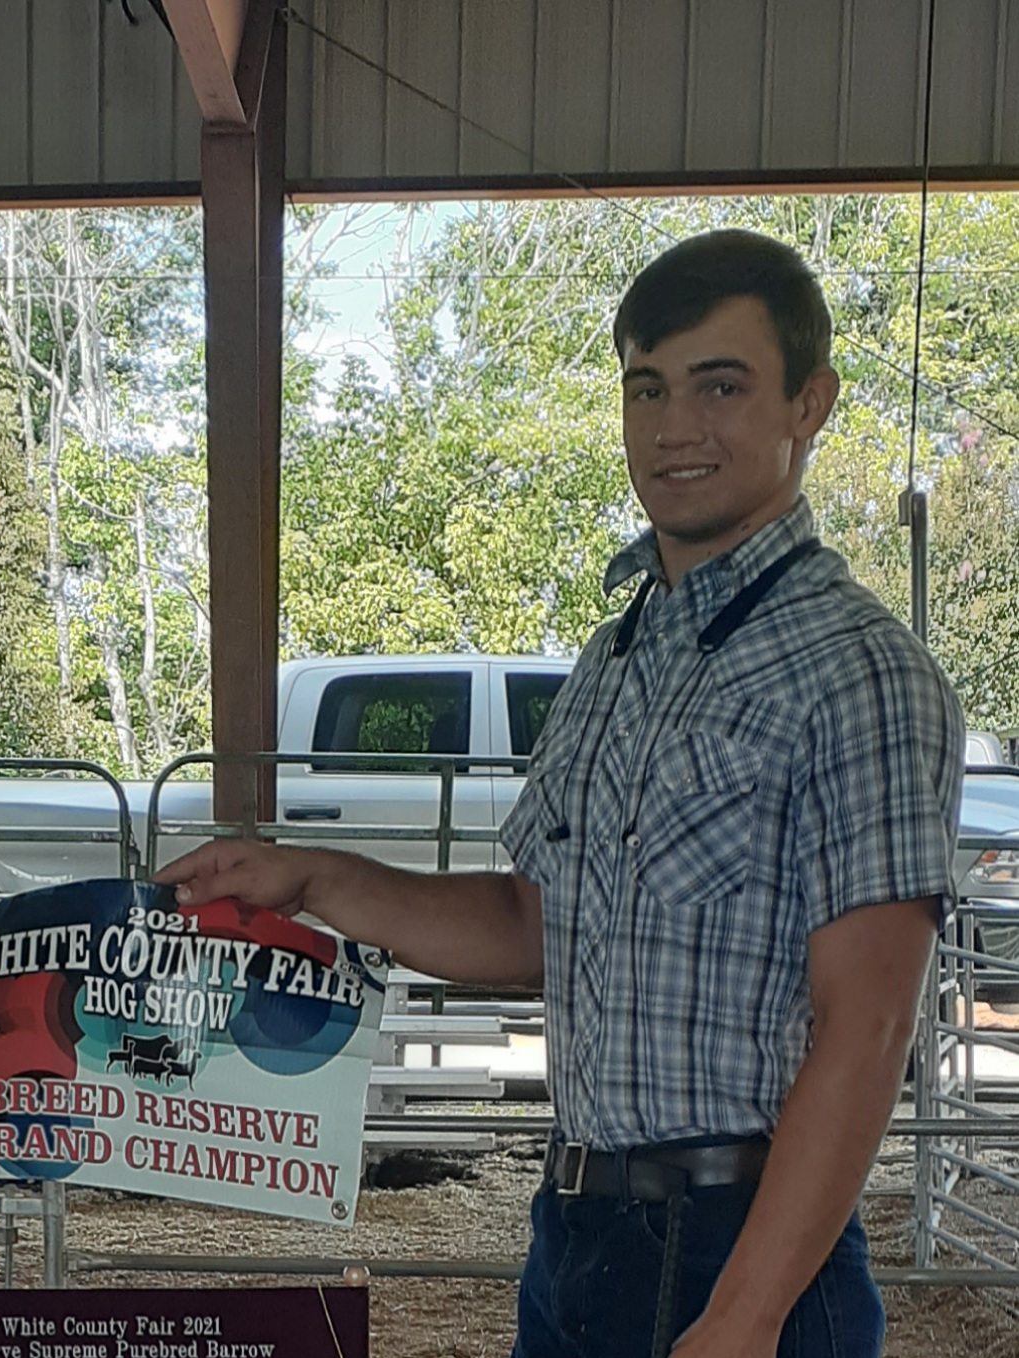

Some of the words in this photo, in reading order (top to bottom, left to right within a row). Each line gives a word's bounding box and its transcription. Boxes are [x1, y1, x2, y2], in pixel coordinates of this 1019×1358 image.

[127, 906, 200, 934] 2021
[98, 926, 260, 989] COUNTY
[262, 947, 365, 1008] FAIR
[83, 975, 138, 1021] HOG
[144, 984, 234, 1031] SHOW
[134, 1090, 320, 1149] RESERVE
[124, 1135, 340, 1199] CHAMPION
[1, 1316, 56, 1336] White
[63, 1316, 128, 1340] County
[136, 1316, 176, 1336] Fair
[183, 1316, 222, 1336] 2021
